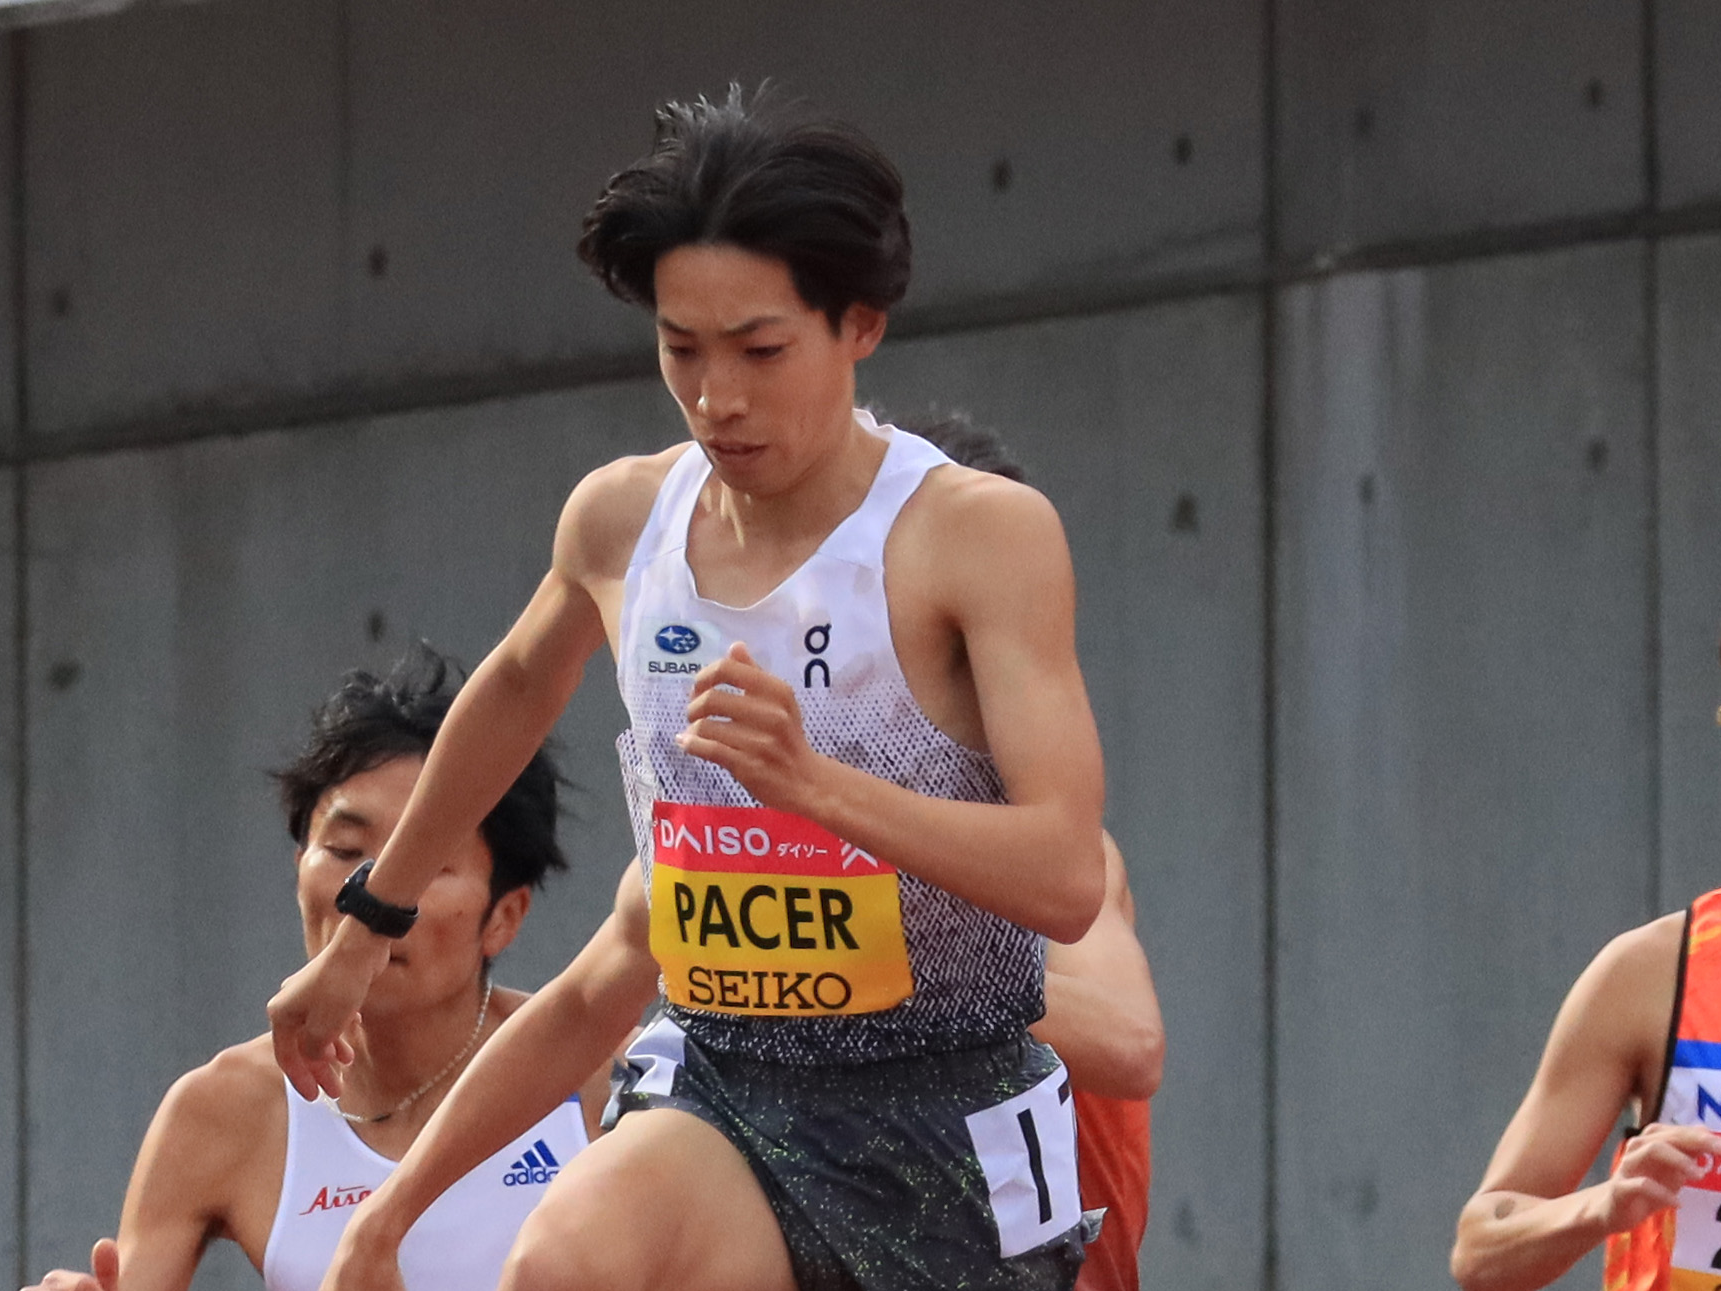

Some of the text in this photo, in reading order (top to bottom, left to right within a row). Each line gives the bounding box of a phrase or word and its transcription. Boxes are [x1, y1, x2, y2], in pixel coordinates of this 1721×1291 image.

[648, 661, 702, 674] SUBAR
[660, 819, 828, 858] DAISO ダイソー
[674, 881, 860, 950] PACER
[688, 966, 852, 1010] SEIKO
[503, 1167, 559, 1187] adid
